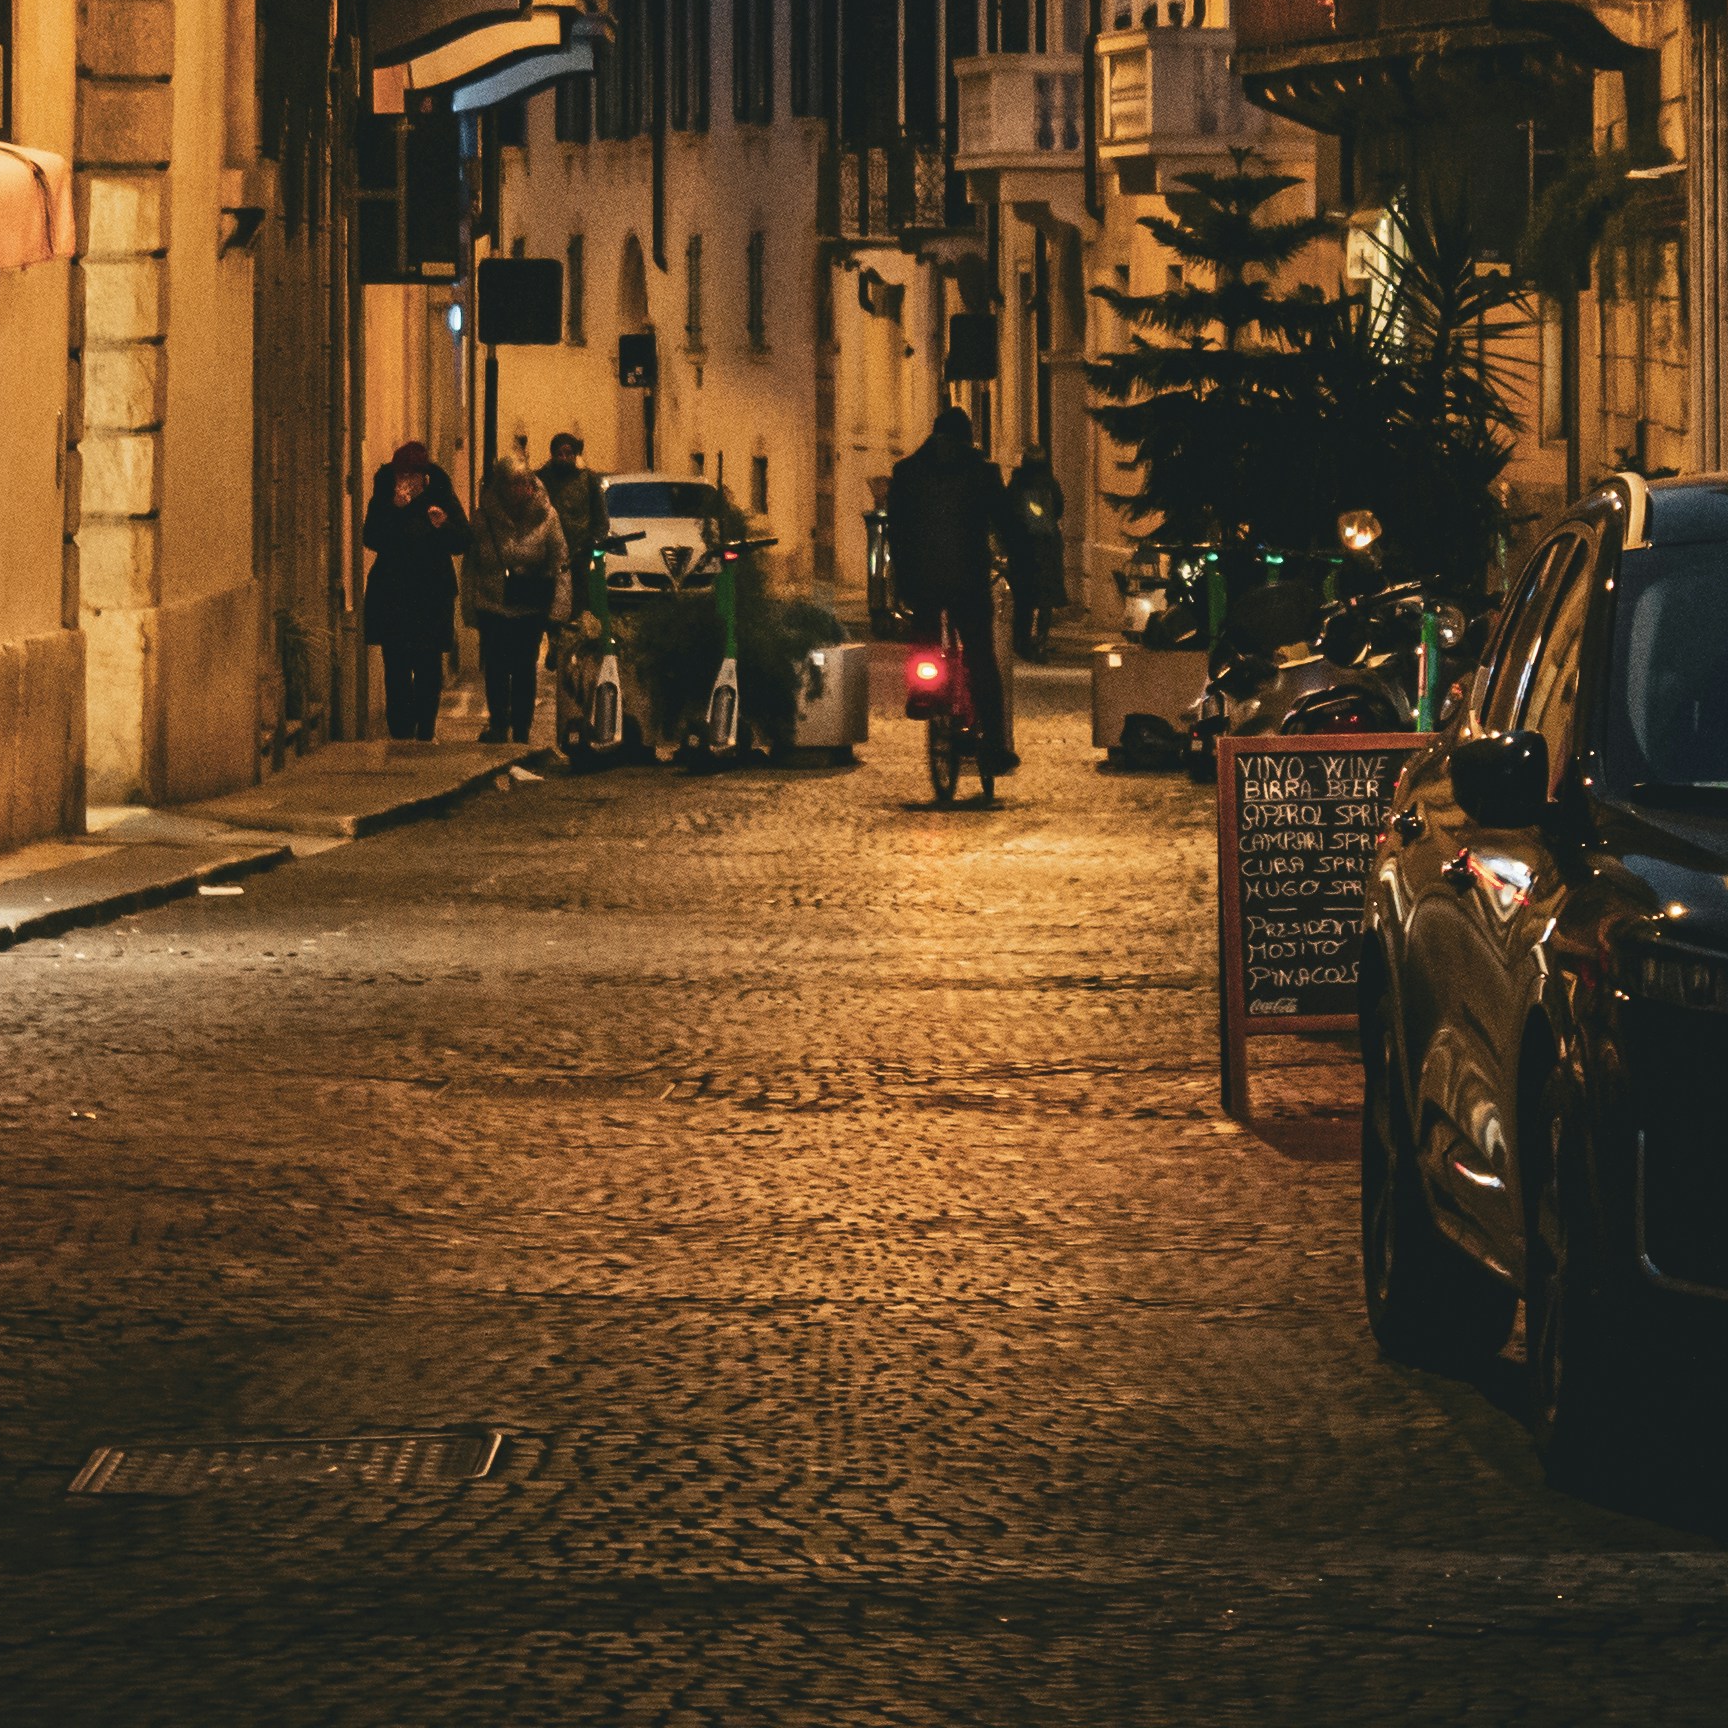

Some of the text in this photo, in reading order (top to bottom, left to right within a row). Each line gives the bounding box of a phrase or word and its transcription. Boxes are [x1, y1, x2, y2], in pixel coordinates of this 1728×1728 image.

[1326, 780, 1379, 798] BEER
[1242, 804, 1327, 830] APEROL
[1239, 831, 1382, 852] CAMPARI SPRI
[1241, 856, 1304, 876] CUBA
[1245, 879, 1368, 902] HUGO SPR
[1248, 939, 1348, 963] MOJITO
